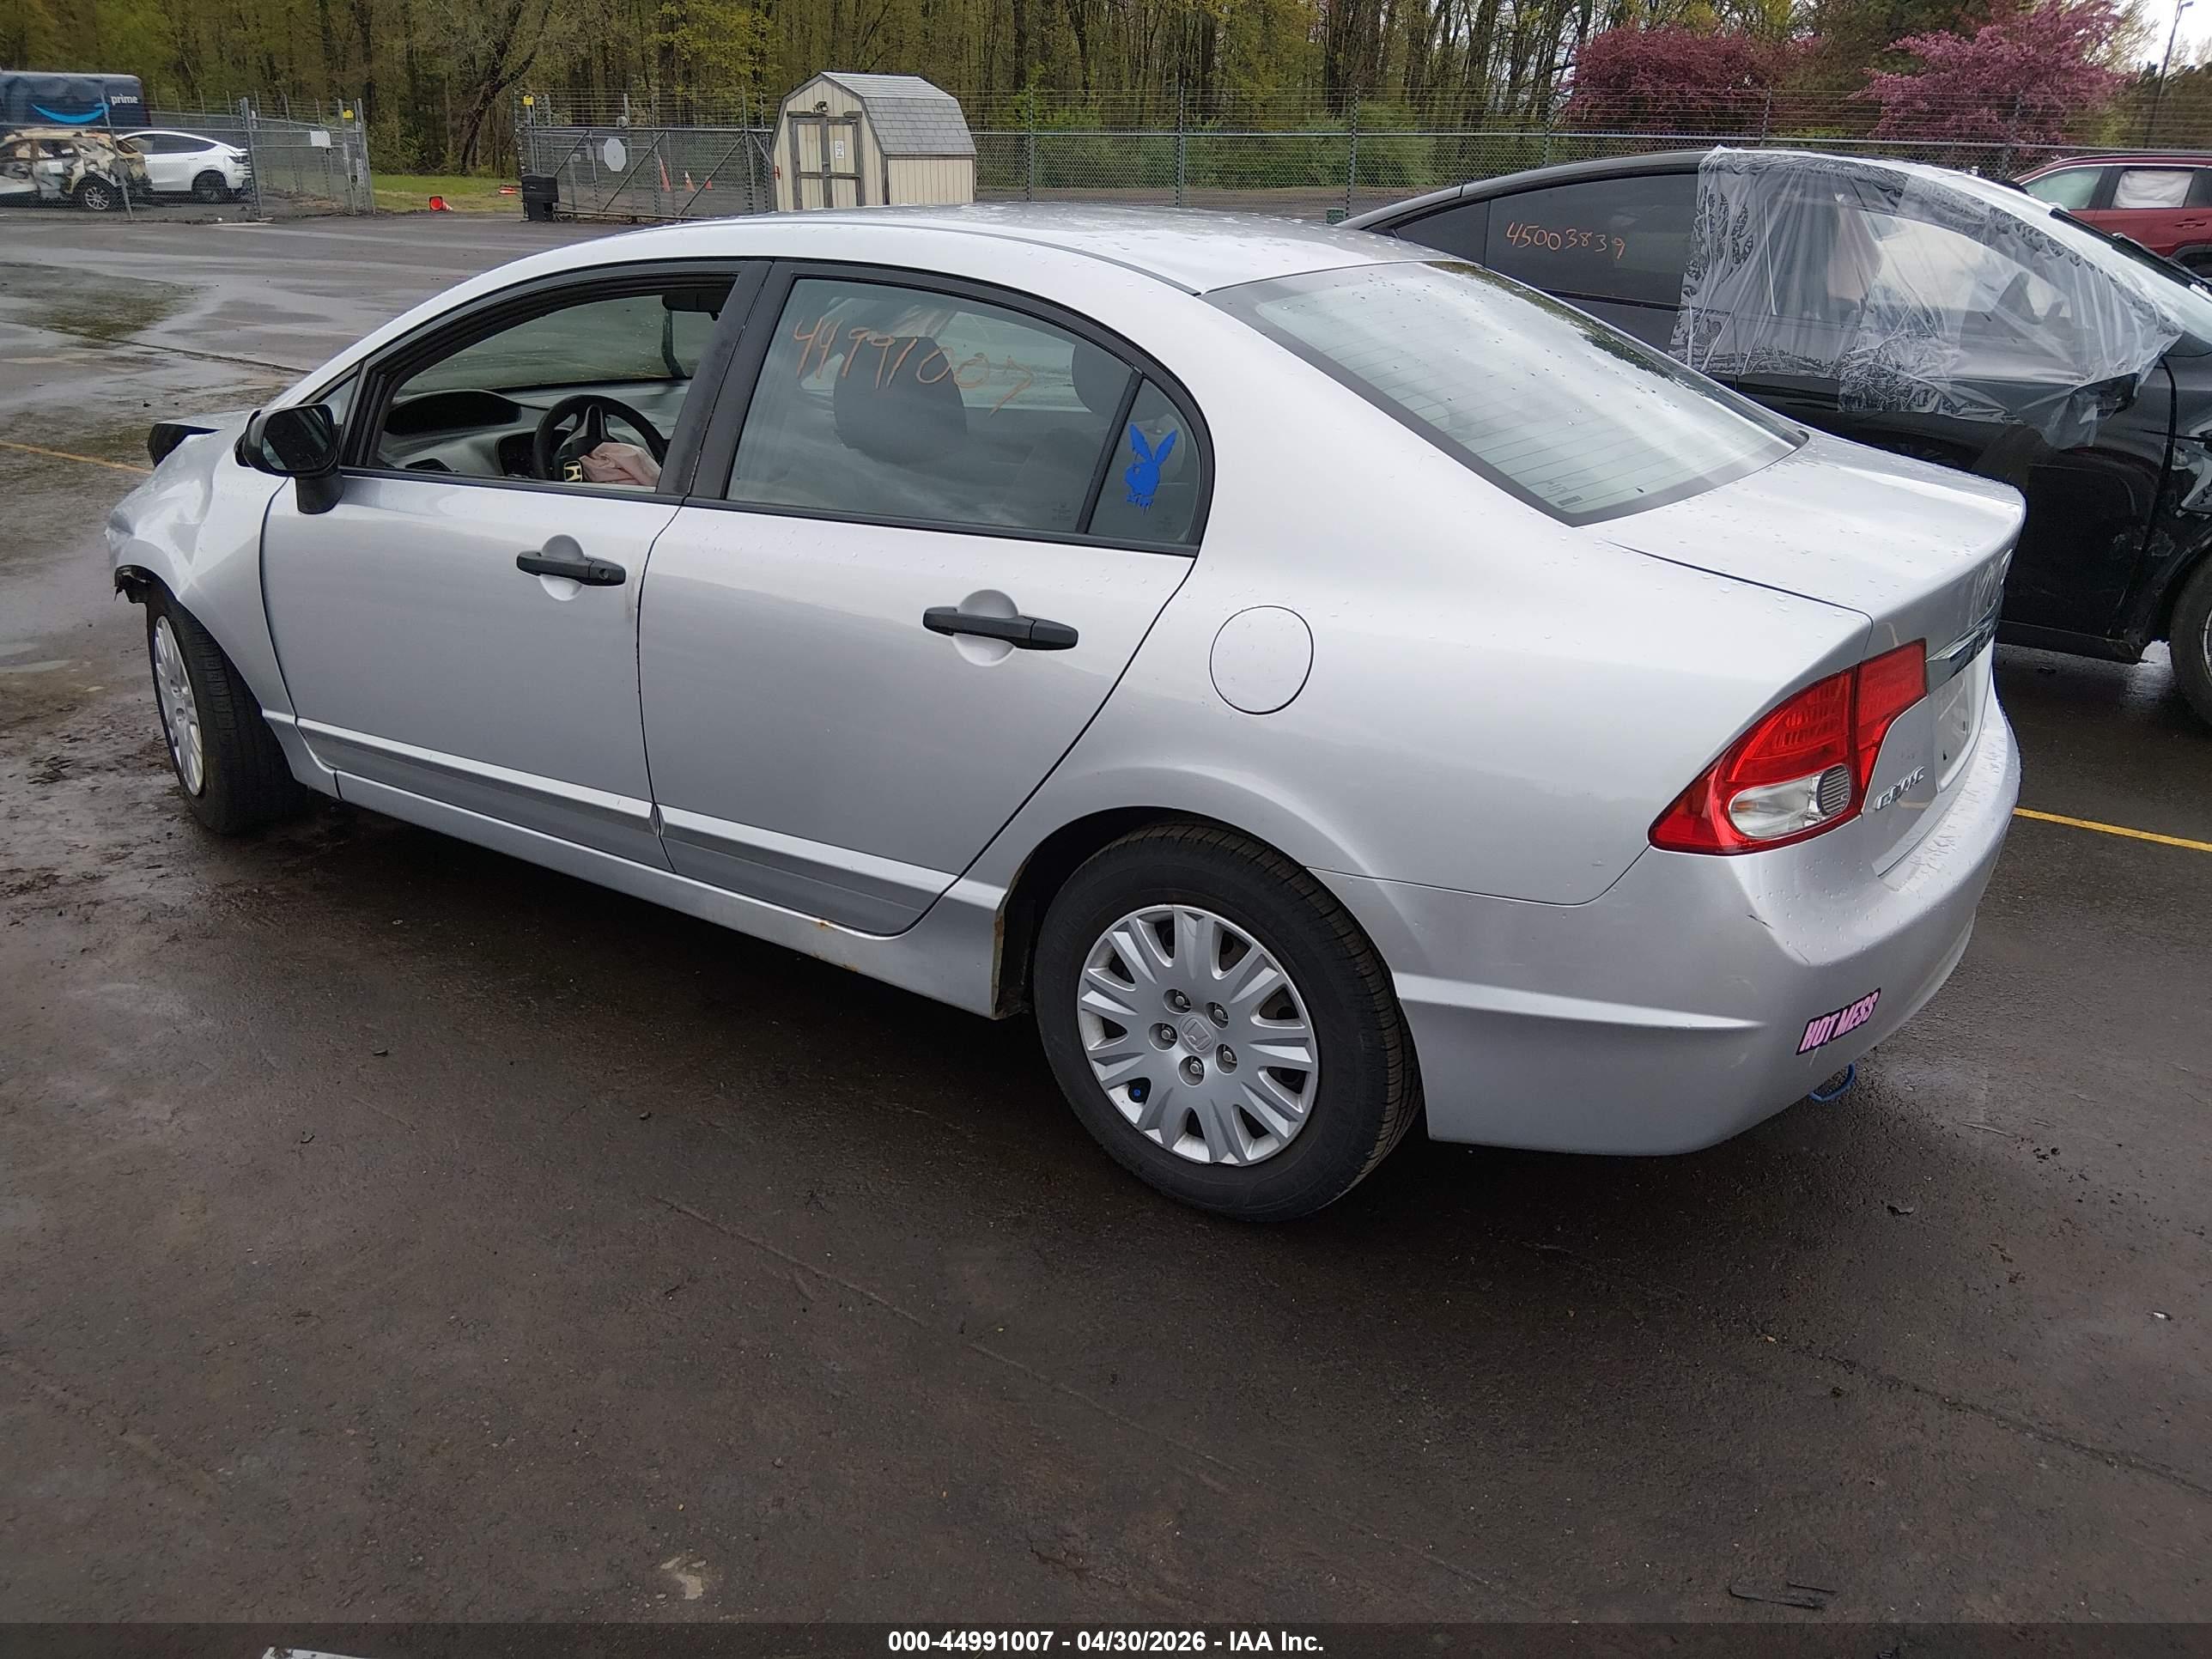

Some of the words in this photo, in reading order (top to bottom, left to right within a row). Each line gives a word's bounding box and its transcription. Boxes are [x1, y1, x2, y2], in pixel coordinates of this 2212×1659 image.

[111, 94, 138, 106] prime
[1506, 222, 1626, 259] 45003839
[793, 317, 1034, 419] 44991007
[1797, 1012, 1841, 1054] HOT
[1832, 990, 1880, 1040] MESS
